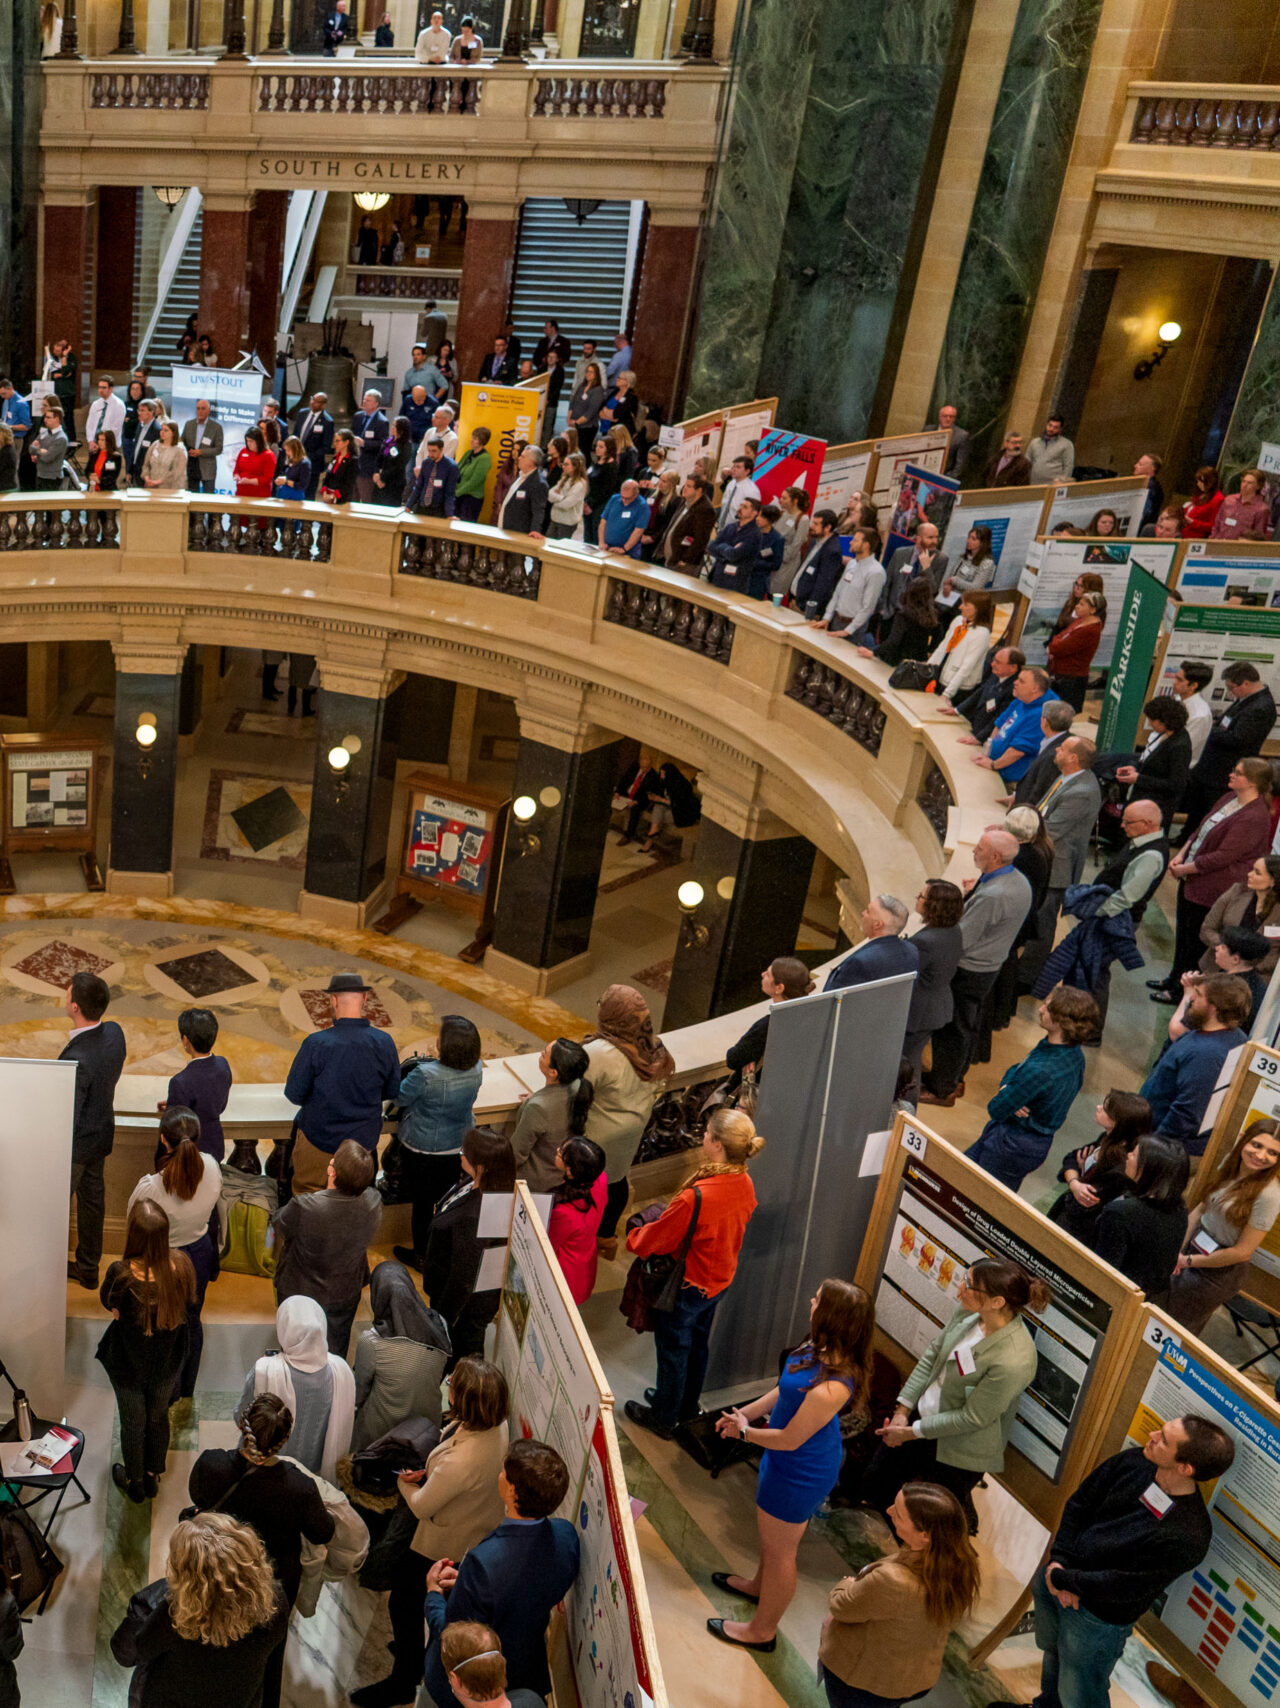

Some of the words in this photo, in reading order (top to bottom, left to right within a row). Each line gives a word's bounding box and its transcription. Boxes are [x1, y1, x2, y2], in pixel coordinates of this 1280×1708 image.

[260, 159, 340, 176] SOUTH
[354, 162, 466, 179] GALLERY
[766, 443, 790, 458] RIVER
[790, 450, 816, 464] FALLS
[1257, 1057, 1278, 1075] 39
[907, 1132, 922, 1150] 33
[950, 1196, 971, 1213] Design
[968, 1209, 976, 1218] of
[974, 1214, 990, 1228] Drug
[988, 1225, 1010, 1244] Loaded
[1008, 1240, 1030, 1259] Double
[1028, 1256, 1053, 1276] Layered
[1051, 1273, 1094, 1308] Microparticles
[1187, 1368, 1227, 1402] Perspectives
[1225, 1399, 1235, 1409] on
[1233, 1406, 1270, 1439] E-Cigarette
[1232, 1417, 1263, 1444] Residing
[1261, 1440, 1270, 1450] in
